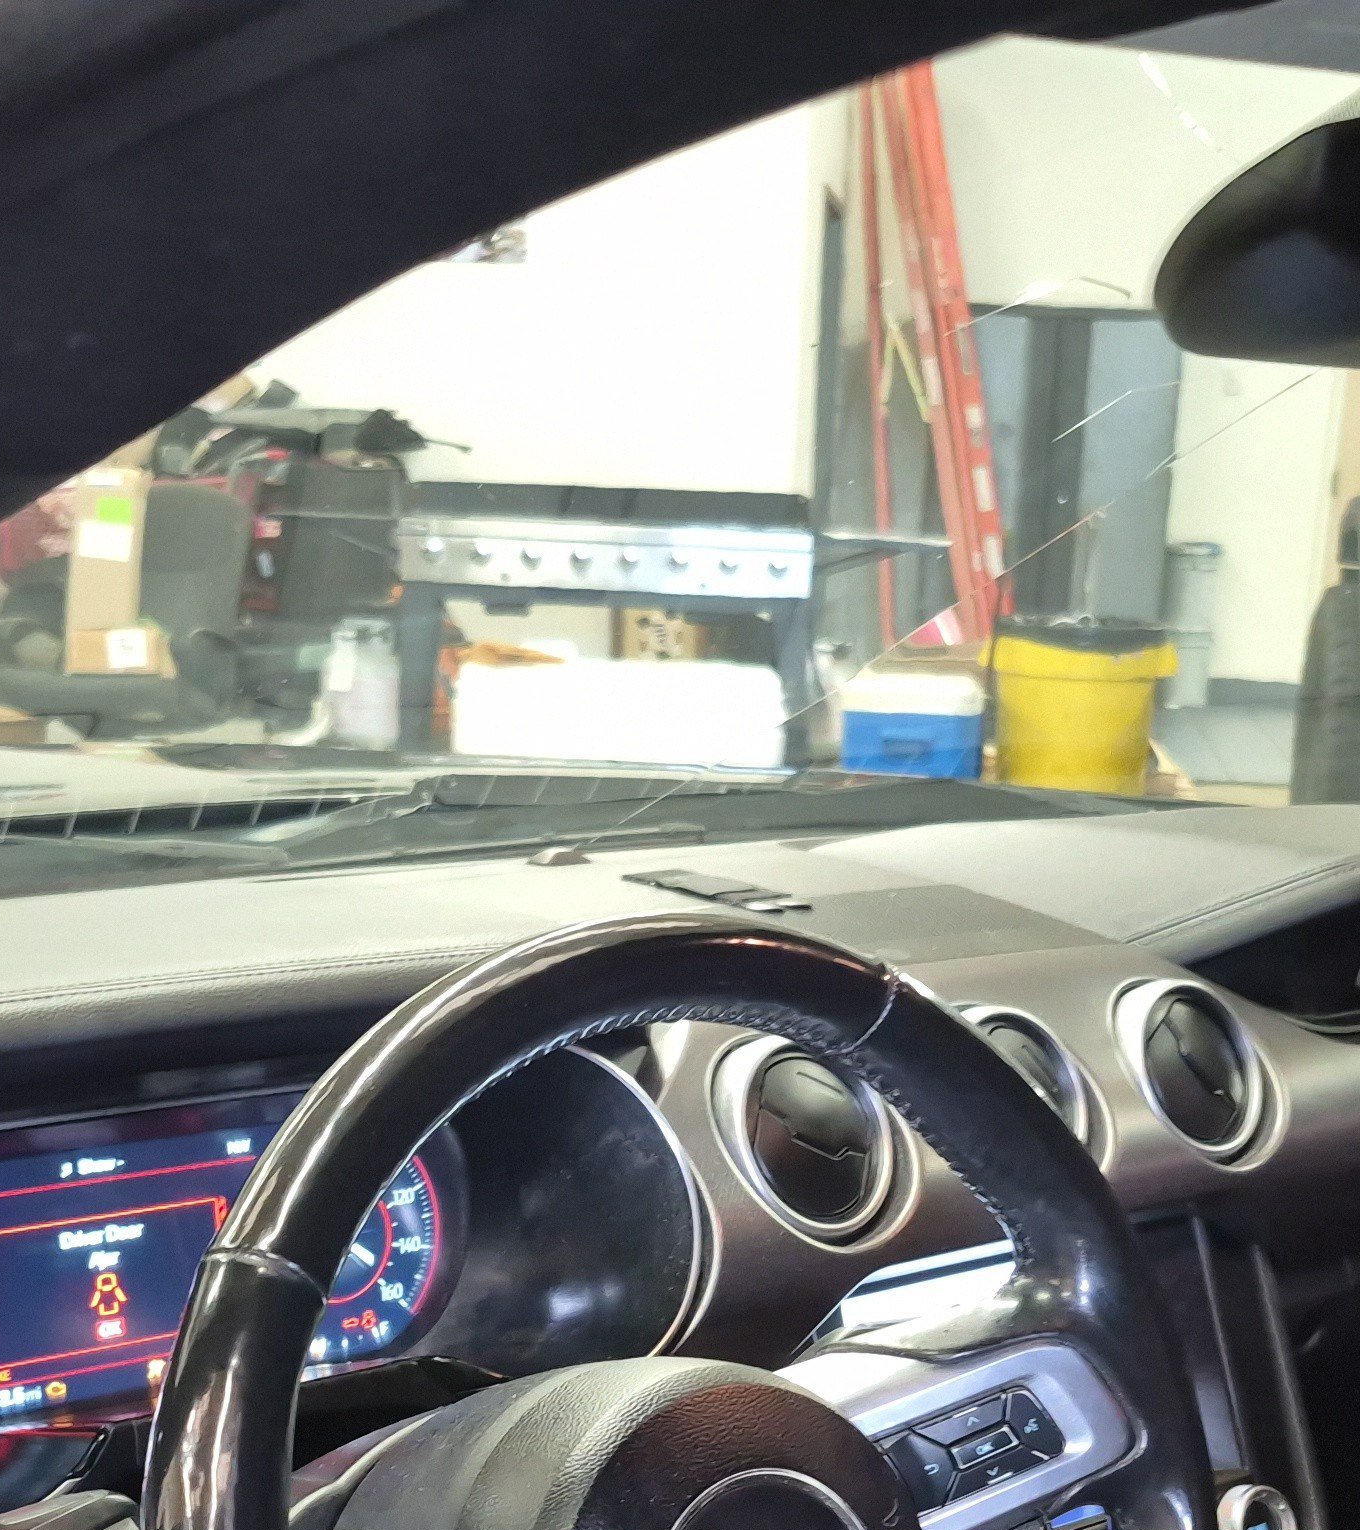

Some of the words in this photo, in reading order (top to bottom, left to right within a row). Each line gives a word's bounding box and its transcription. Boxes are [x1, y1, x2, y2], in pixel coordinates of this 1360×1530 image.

[392, 1187, 416, 1206] 120
[104, 1223, 144, 1243] Door
[398, 1236, 422, 1255] 140
[380, 1282, 404, 1302] 160
